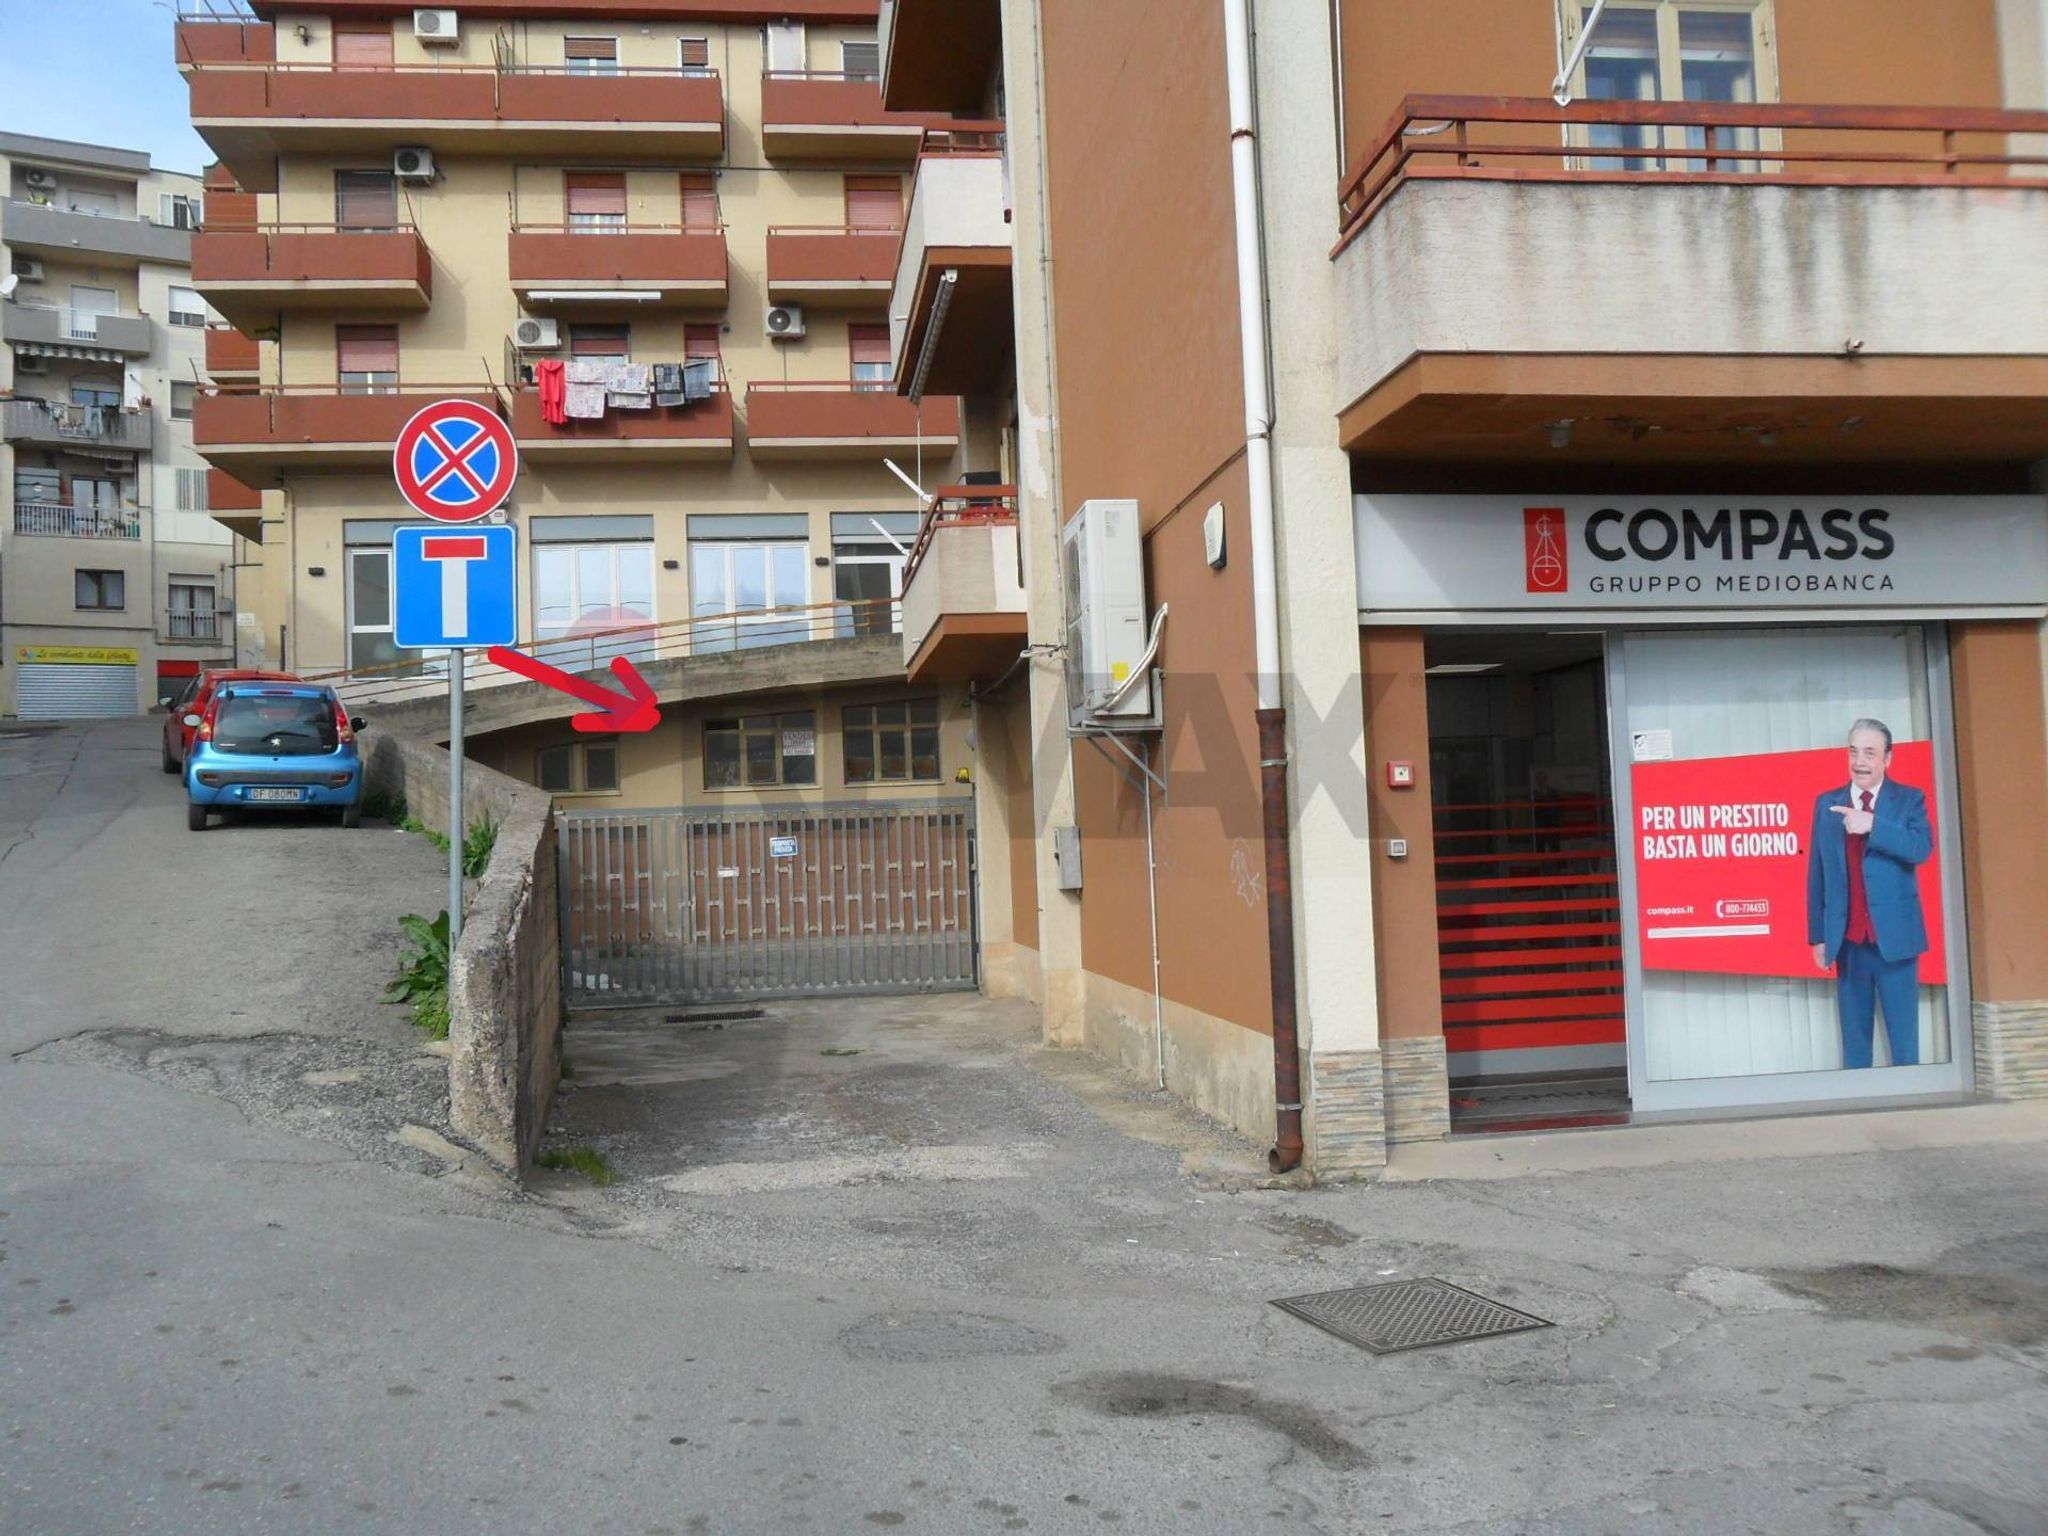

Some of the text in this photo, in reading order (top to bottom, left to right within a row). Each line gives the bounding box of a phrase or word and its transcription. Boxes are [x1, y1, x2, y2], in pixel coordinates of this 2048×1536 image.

[1584, 508, 1895, 562] COMPASS
[1589, 574, 1895, 593] GRUPPO MEDIOBANCA
[1642, 803, 1789, 830] PER UN PRESTITO
[1643, 832, 1803, 860] BASTA UN GIORNO.
[1647, 905, 1694, 917] compass.it
